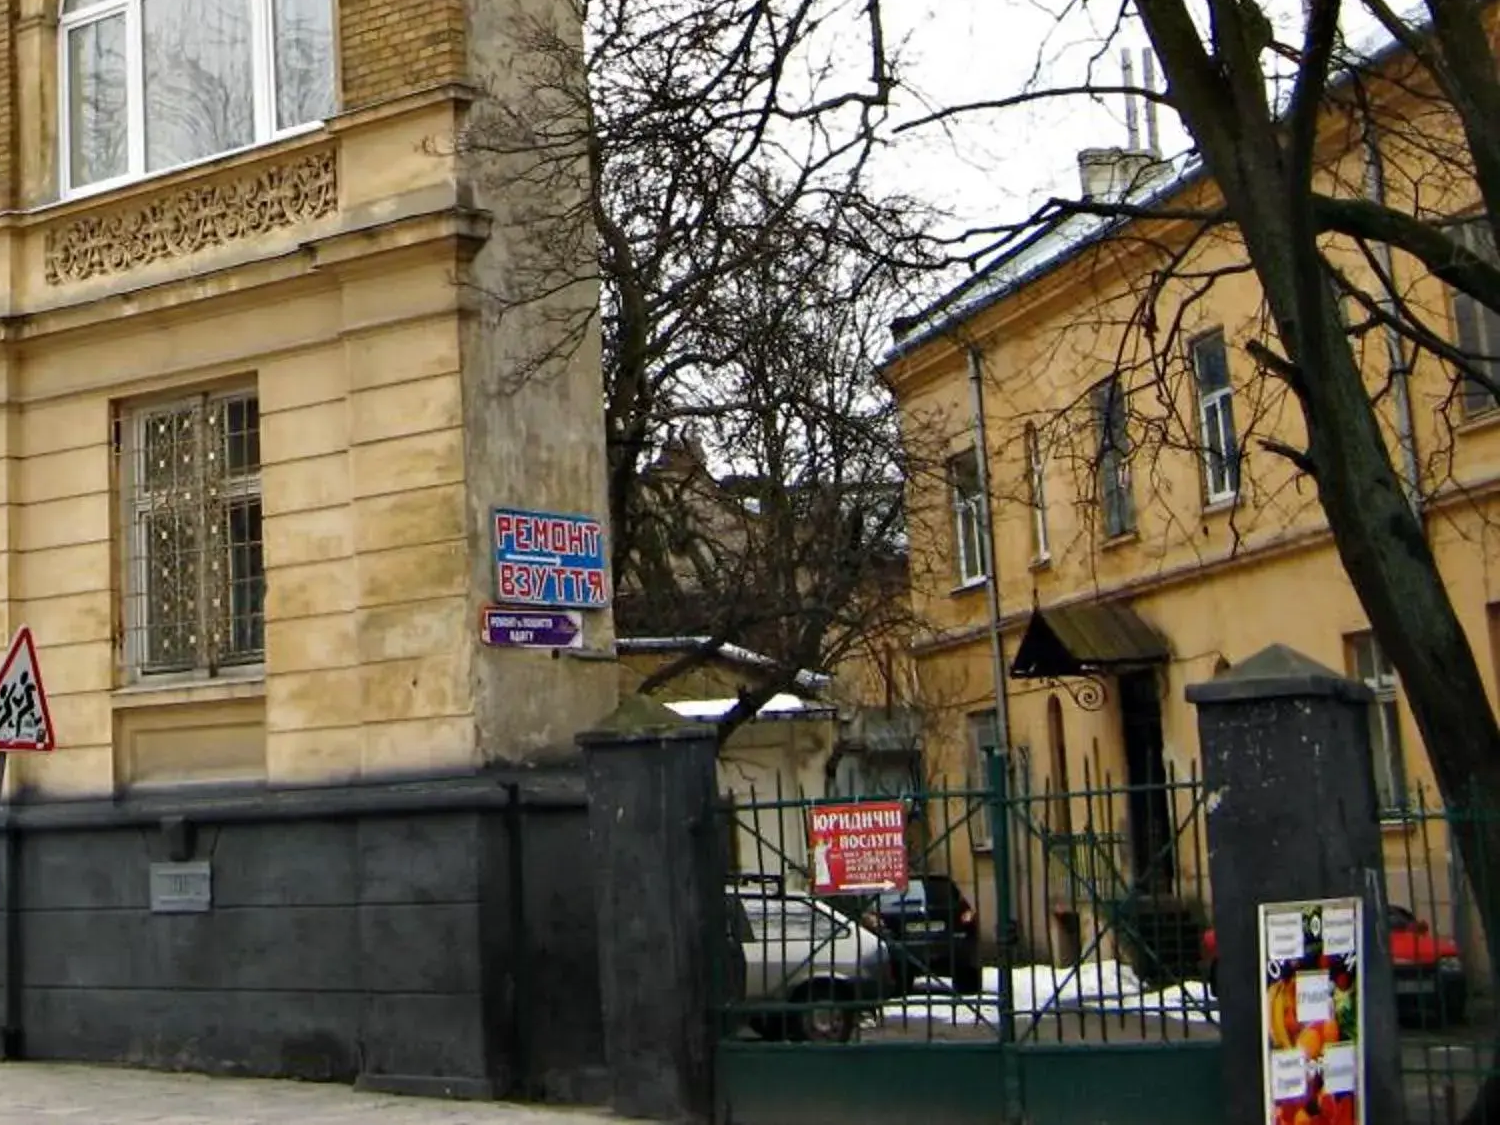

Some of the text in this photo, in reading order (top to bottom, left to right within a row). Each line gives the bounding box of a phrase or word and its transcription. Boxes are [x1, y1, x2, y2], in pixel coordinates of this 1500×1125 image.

[496, 515, 599, 556] РЕМОНТ
[500, 562, 606, 603] ВЗУТТЯ
[813, 810, 901, 831] ЮРИДИЧНІ
[840, 832, 902, 849] ПОСЛУГИ
